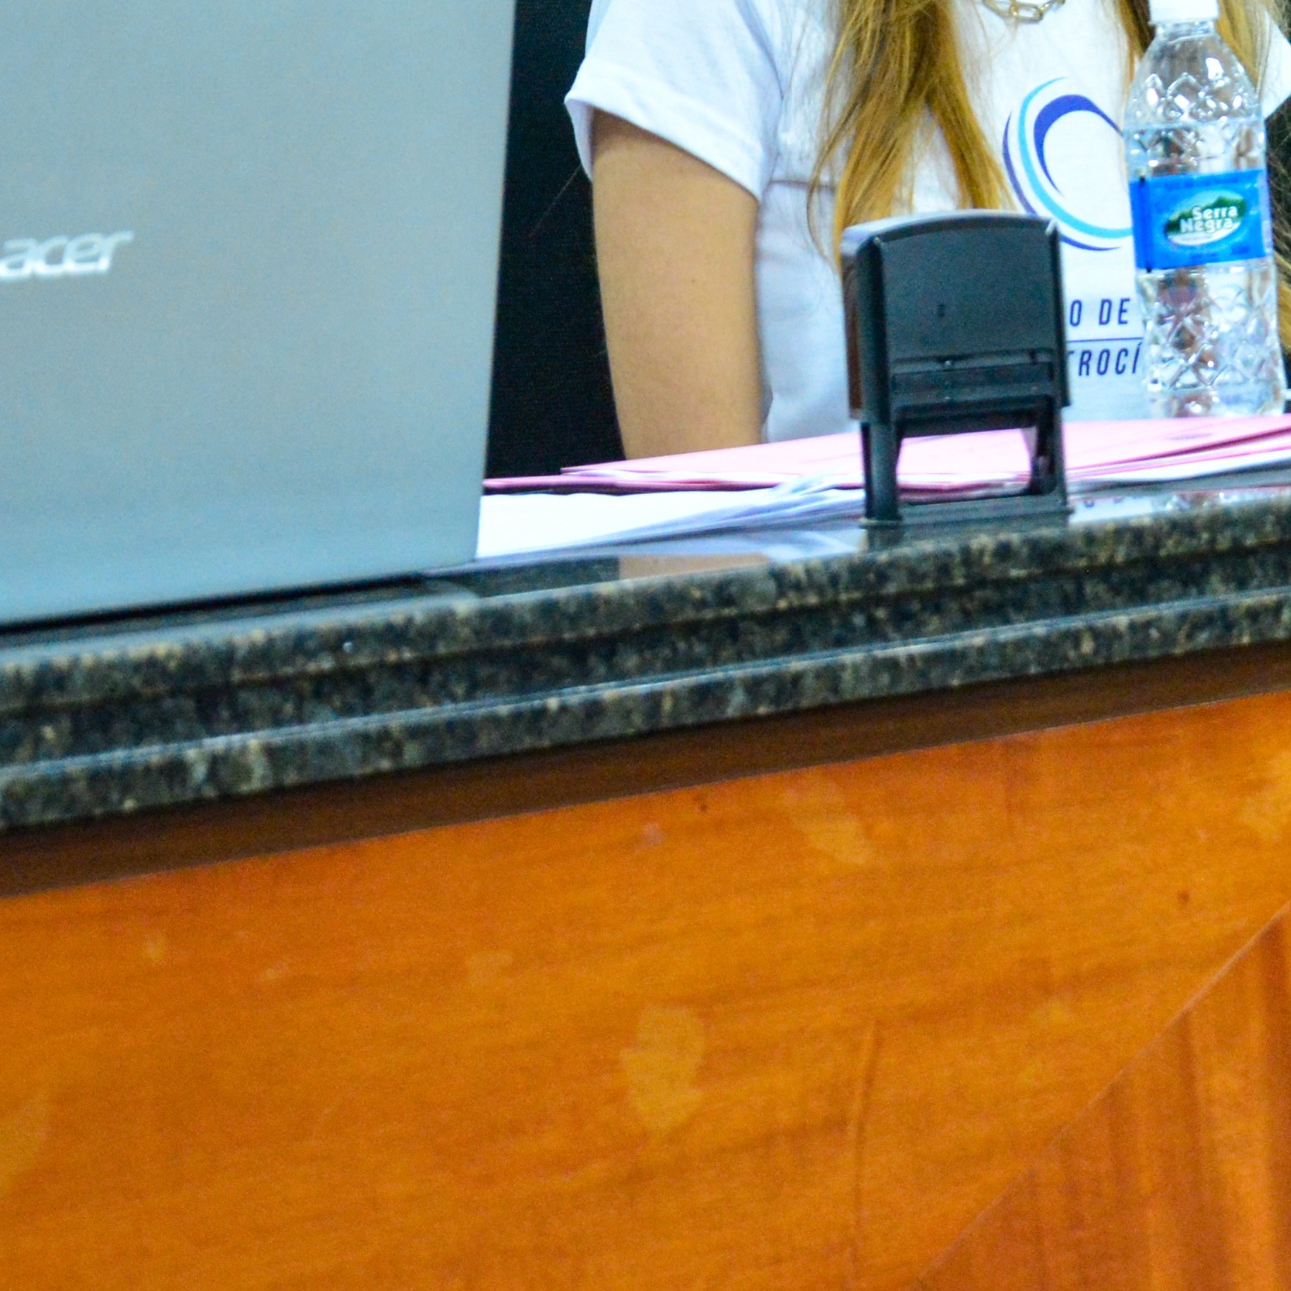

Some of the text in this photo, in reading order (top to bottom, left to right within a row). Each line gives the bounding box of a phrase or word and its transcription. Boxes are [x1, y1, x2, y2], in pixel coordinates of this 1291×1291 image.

[1192, 205, 1239, 221] Serra
[1179, 217, 1234, 235] Negra
[0, 229, 135, 280] acer
[1098, 297, 1131, 326] DE
